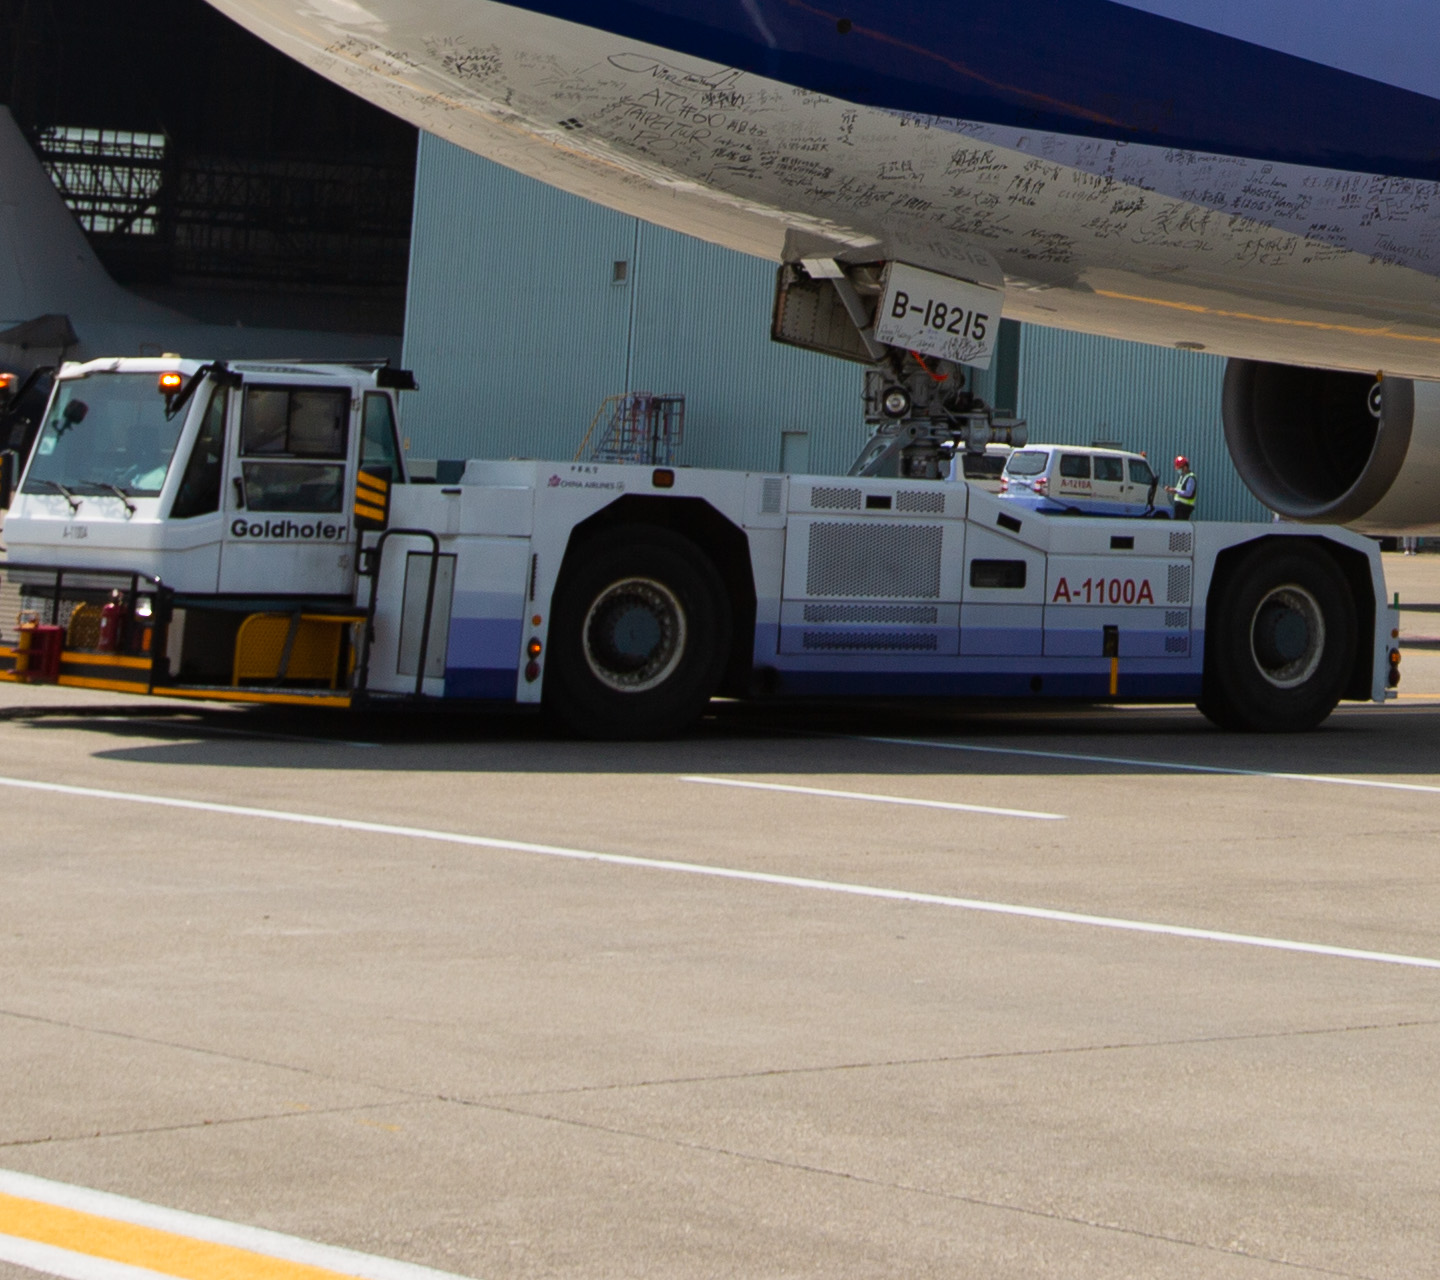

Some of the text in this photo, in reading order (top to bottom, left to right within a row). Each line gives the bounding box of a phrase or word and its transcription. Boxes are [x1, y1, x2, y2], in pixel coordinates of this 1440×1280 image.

[890, 290, 989, 341] B-18215
[230, 518, 346, 540] Goldhofer
[1052, 576, 1155, 605] A-1100A
